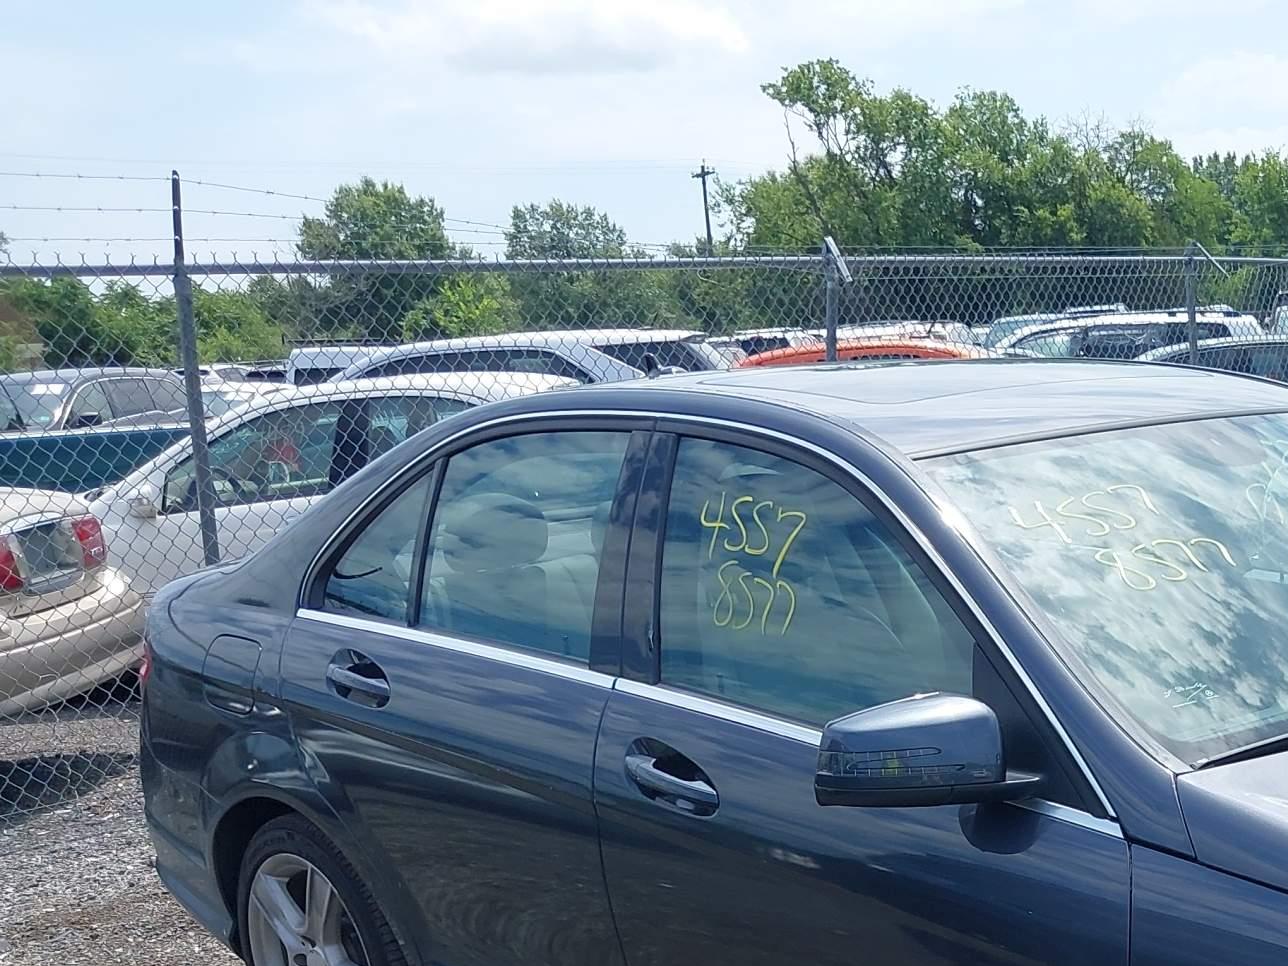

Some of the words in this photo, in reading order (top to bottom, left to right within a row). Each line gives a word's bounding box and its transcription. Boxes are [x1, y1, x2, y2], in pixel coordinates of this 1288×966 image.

[701, 491, 807, 579] 4557
[1007, 484, 1160, 544] 4557
[713, 560, 797, 635] 8577
[1094, 537, 1237, 591] 8577
